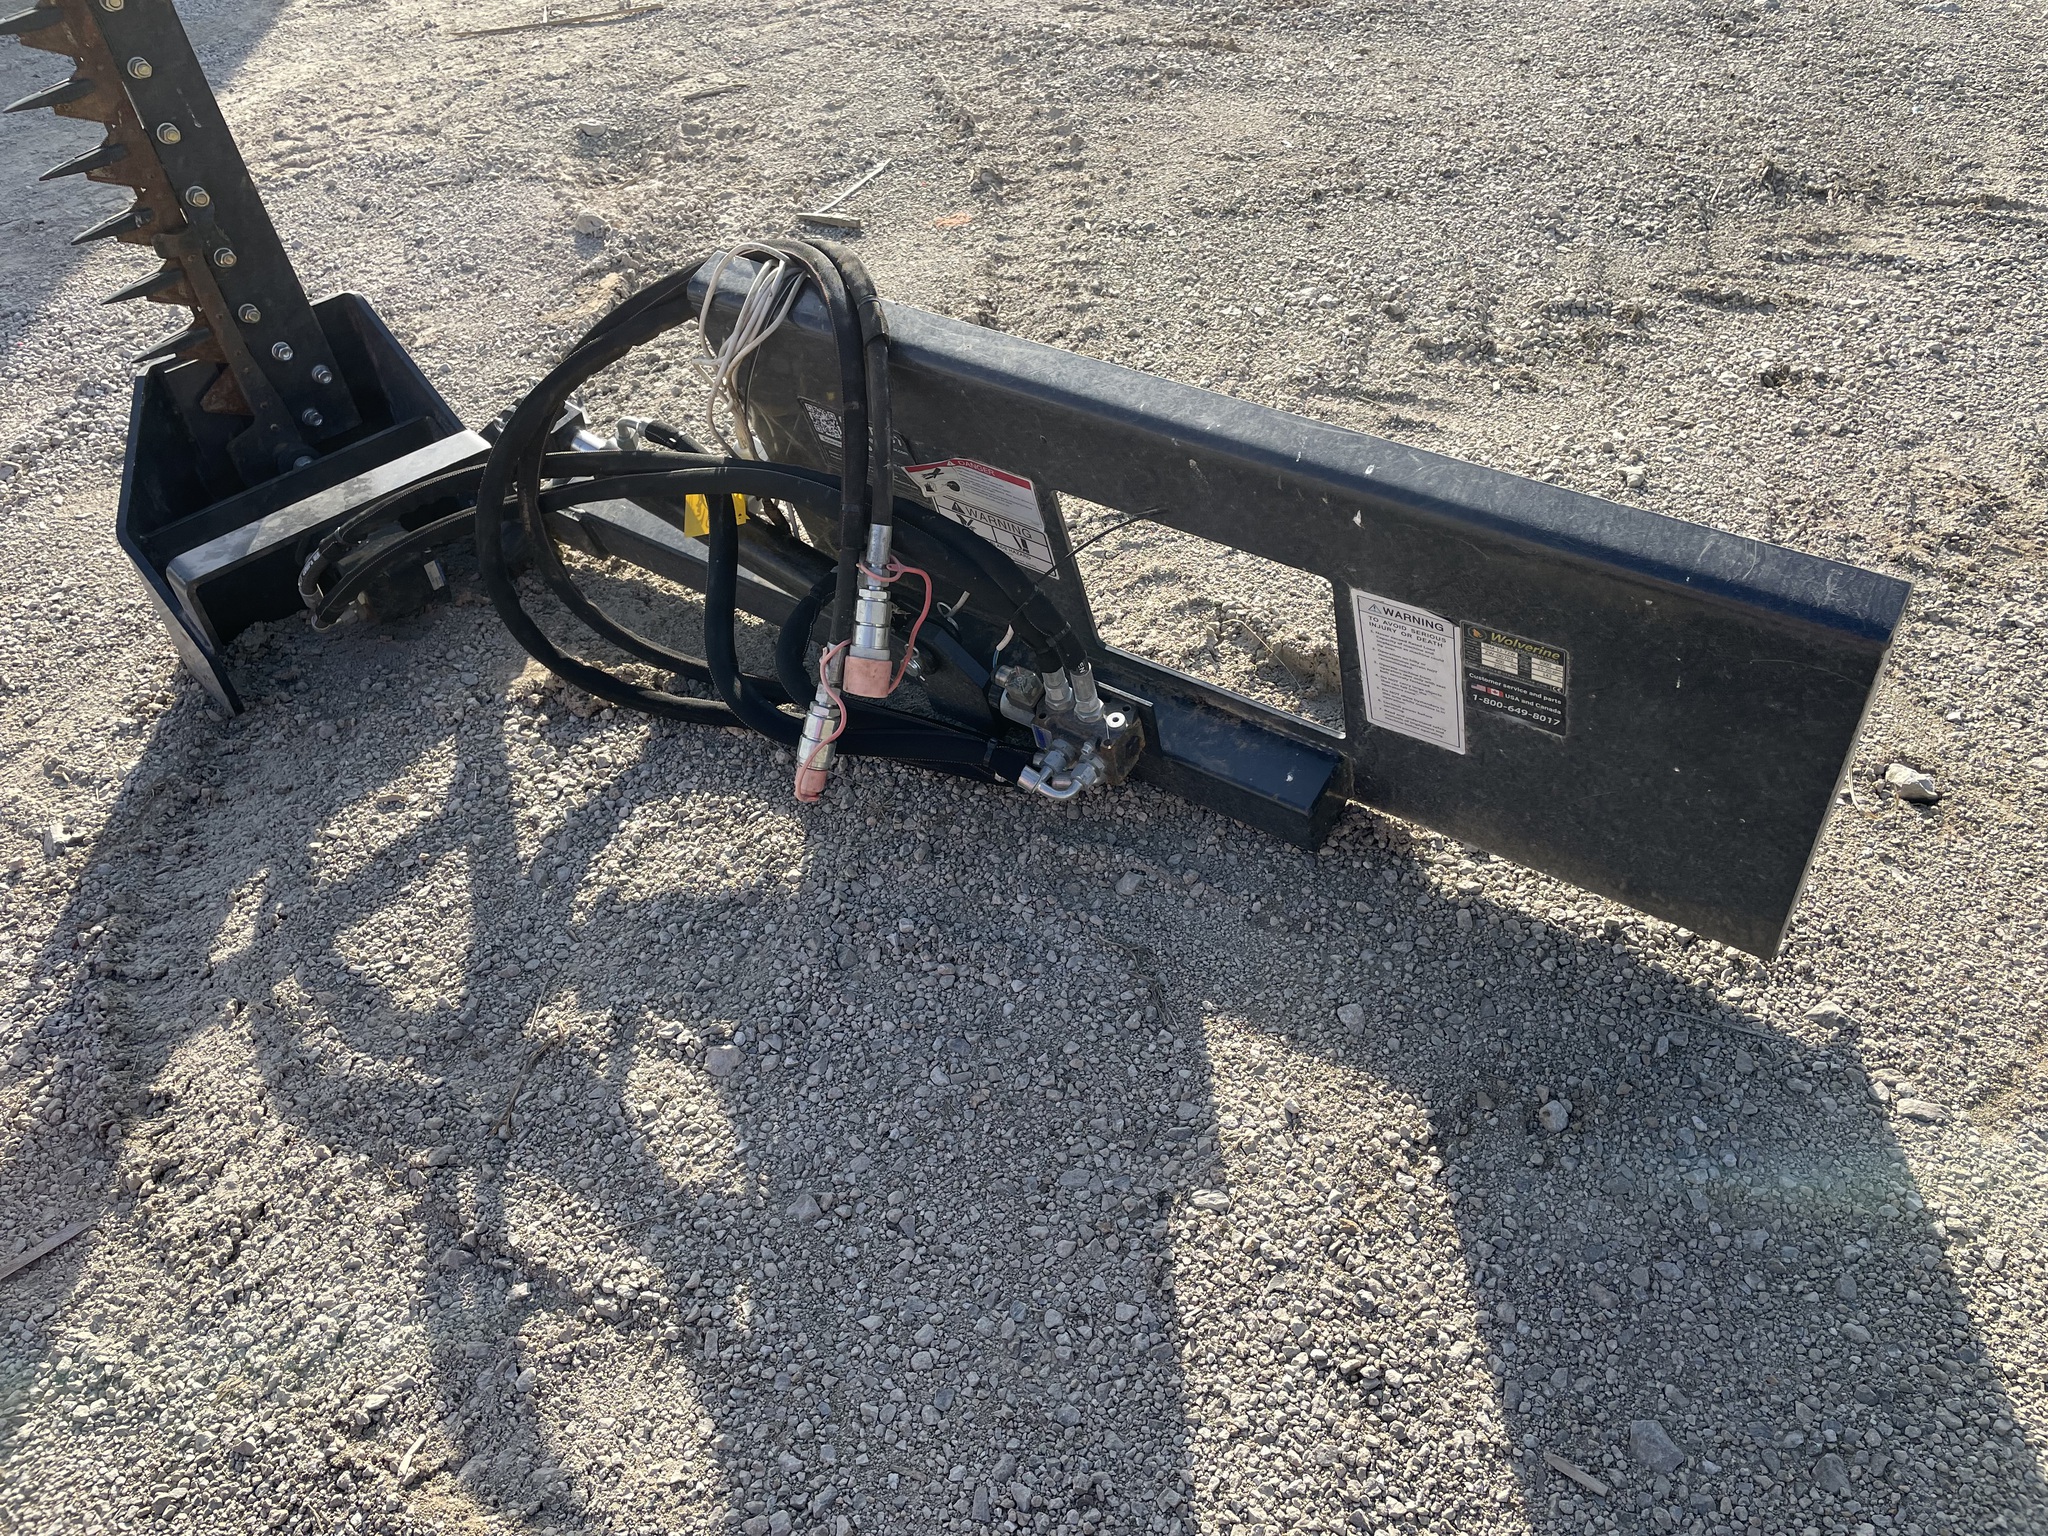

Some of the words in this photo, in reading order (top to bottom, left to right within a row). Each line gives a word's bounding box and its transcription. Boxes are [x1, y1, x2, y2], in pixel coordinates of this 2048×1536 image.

[958, 461, 995, 476] DANGER
[966, 507, 1032, 539] WARNING
[1383, 607, 1444, 632] WARNING
[1383, 620, 1406, 631] AVOID
[1411, 628, 1446, 643] SERIOUS
[1369, 622, 1397, 633] INJURY
[1417, 637, 1443, 648] DEATH
[1491, 632, 1560, 660] Wolverine
[1469, 673, 1501, 687] Customer
[1503, 683, 1527, 695] service
[1543, 696, 1561, 704] parts
[1473, 694, 1560, 726] 1-800-649-8017
[1505, 693, 1519, 702] USA
[1535, 702, 1561, 715] Canada
